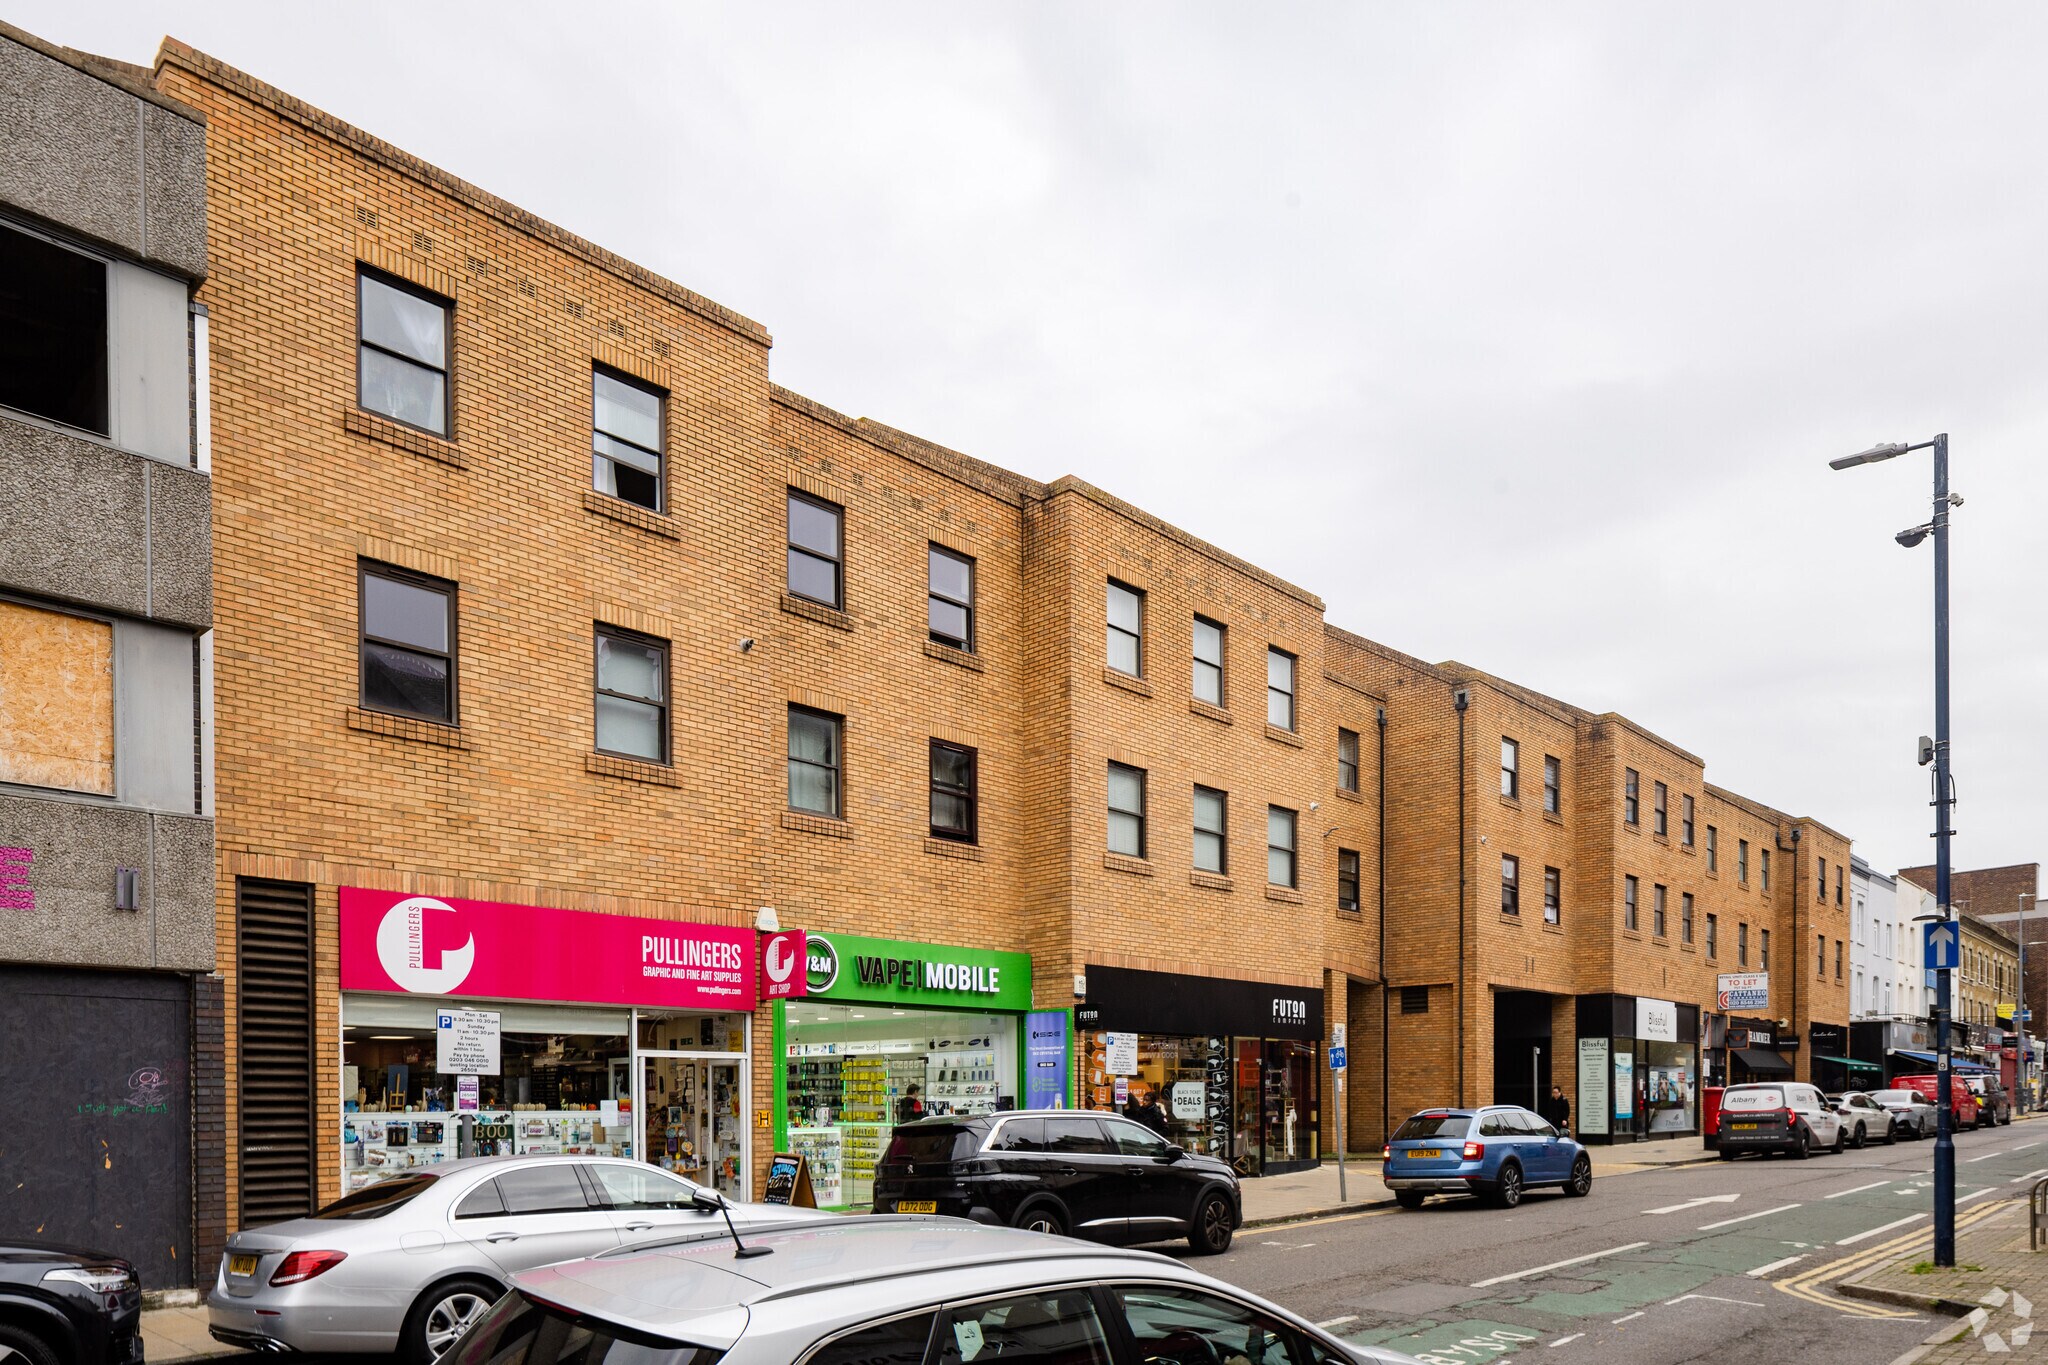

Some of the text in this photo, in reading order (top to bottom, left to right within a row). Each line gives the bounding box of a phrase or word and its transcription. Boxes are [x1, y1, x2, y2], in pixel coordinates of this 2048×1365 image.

[408, 906, 420, 969] PULLINGERS
[642, 936, 742, 970] PULLINGERS
[643, 966, 742, 983] GRAPHIC AND FINE ART SUPPLIES
[857, 955, 1000, 993] VAPE MOBILE
[697, 986, 742, 996] www.pullingers.com
[769, 983, 791, 994] ART SHOP
[1273, 998, 1305, 1018] FUTON
[1178, 1097, 1201, 1105] DEALS
[760, 1112, 768, 1125] H
[475, 1125, 507, 1138] BOO
[901, 1202, 918, 1211] LD72
